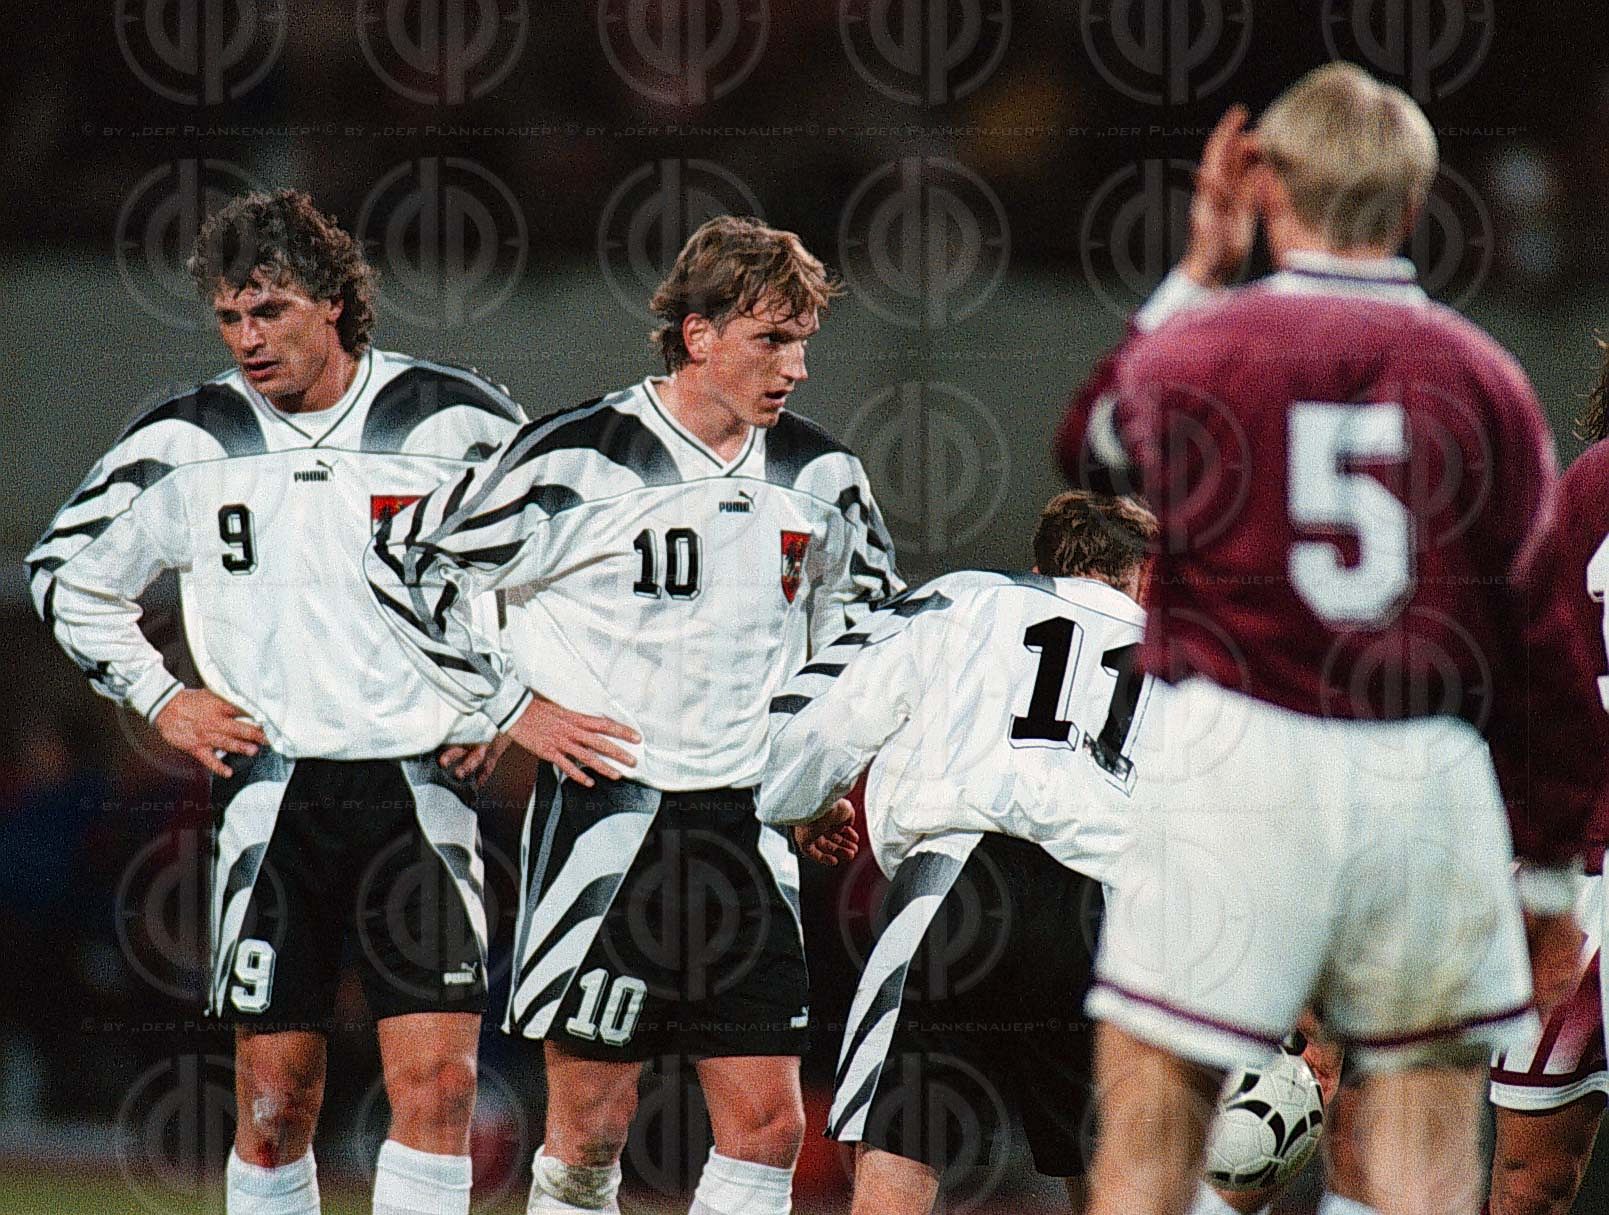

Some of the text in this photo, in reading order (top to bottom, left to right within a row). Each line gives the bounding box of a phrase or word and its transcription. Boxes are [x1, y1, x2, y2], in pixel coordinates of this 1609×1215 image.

[218, 503, 258, 576] 9
[1287, 401, 1413, 628] 5
[633, 527, 703, 600] 10
[1007, 616, 1154, 798] 11
[231, 938, 276, 1013] 9
[565, 967, 648, 1047] 10
